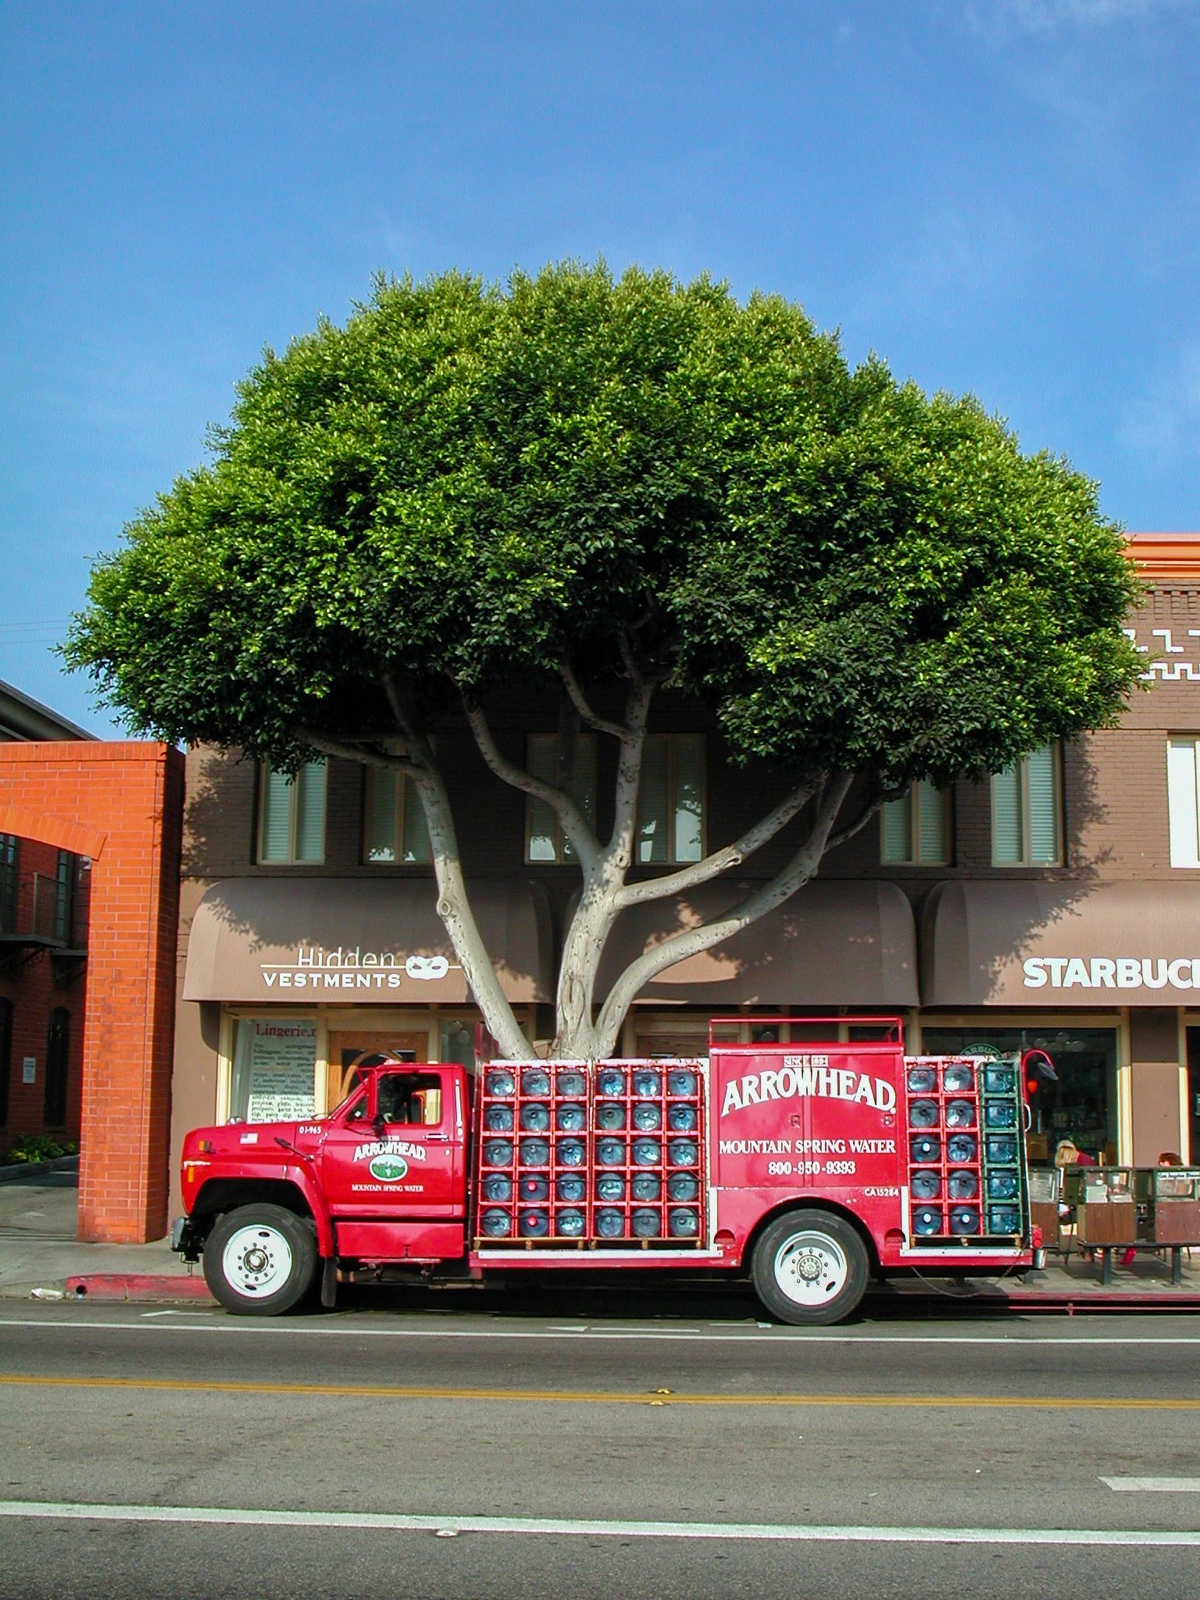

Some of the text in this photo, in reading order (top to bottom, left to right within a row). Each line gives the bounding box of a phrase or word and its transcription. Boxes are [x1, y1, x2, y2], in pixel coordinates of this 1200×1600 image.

[298, 946, 395, 967] Hidden
[262, 972, 401, 988] VESTMENTS
[719, 1139, 896, 1154] MOUNTAIN SPRING WATER
[768, 1161, 856, 1175] 800-950-9393
[351, 1184, 424, 1192] MOUNTAIN SPRING WATER
